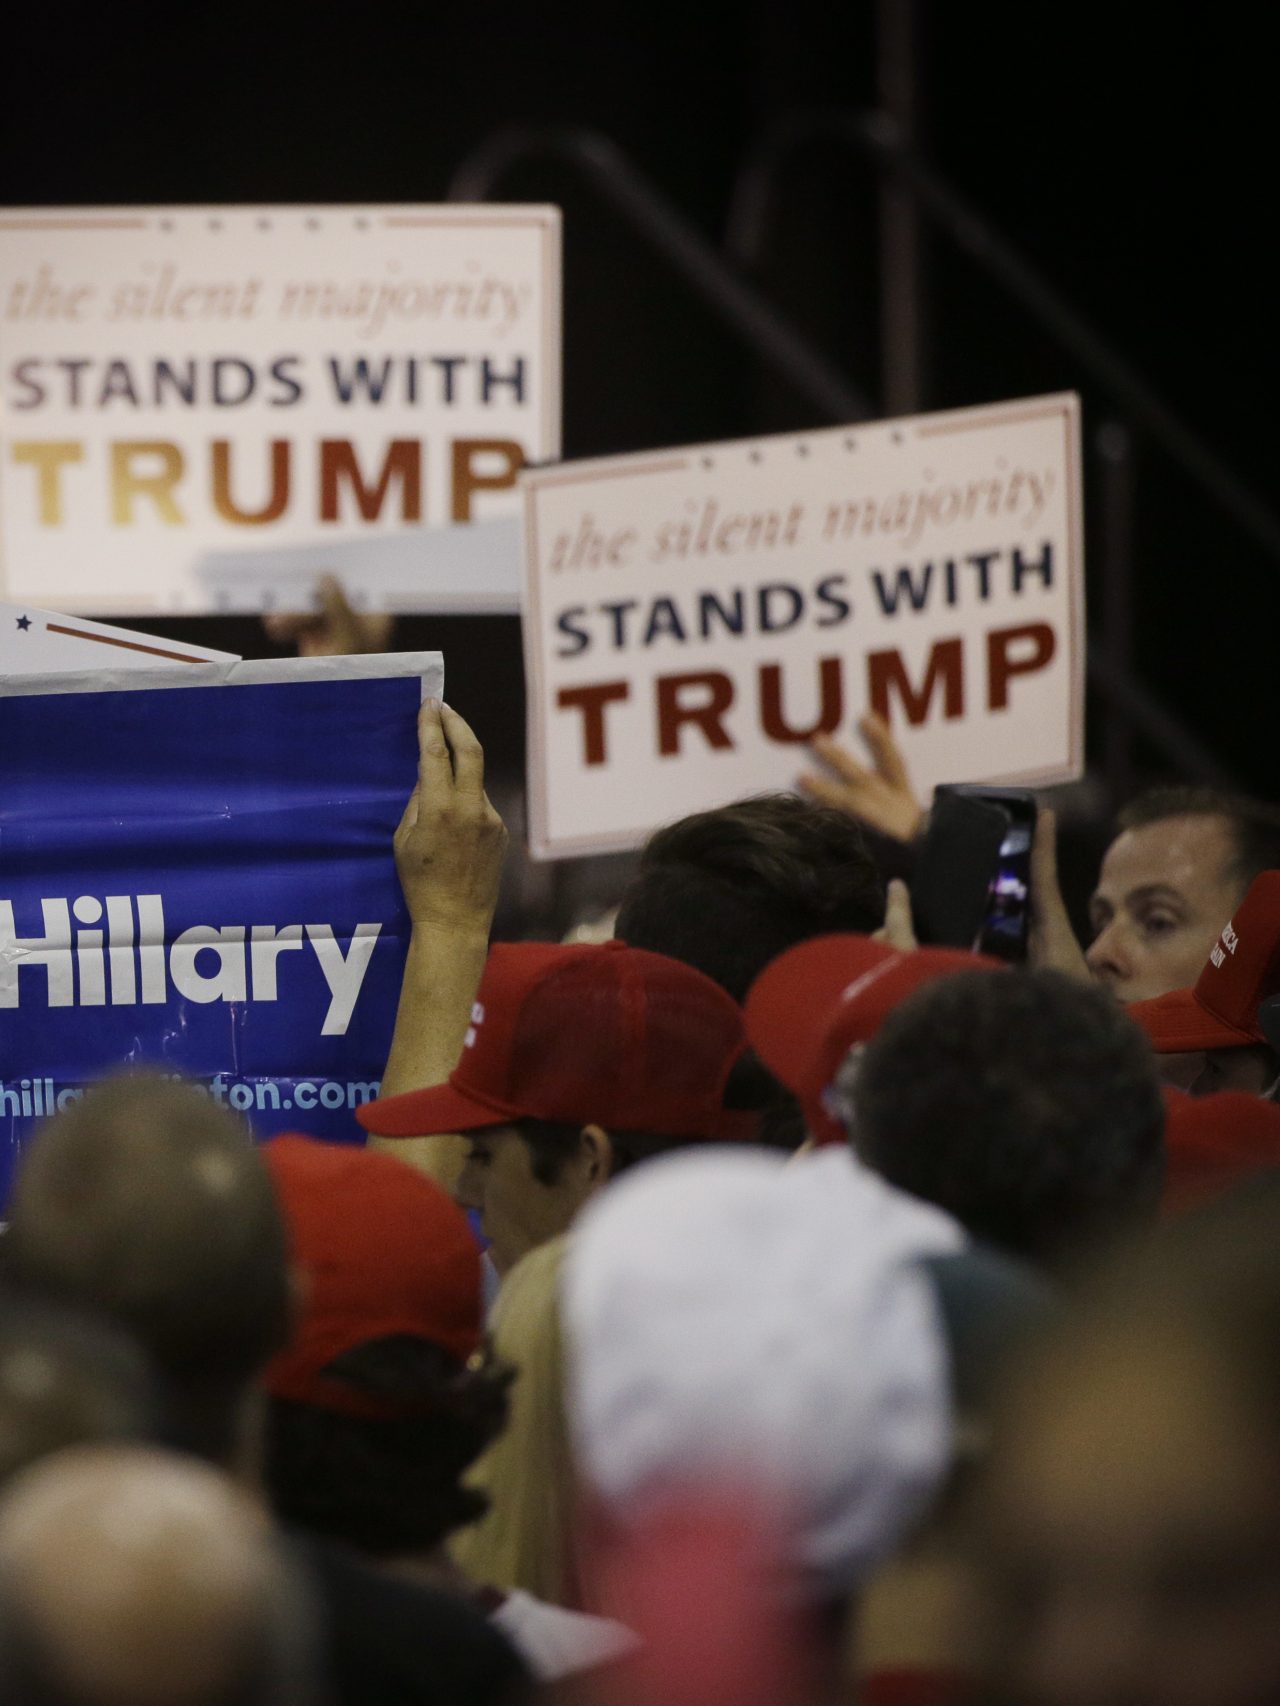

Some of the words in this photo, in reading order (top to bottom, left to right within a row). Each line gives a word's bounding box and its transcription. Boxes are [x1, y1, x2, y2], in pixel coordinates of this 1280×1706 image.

[6, 260, 89, 324] the
[100, 260, 266, 322] silent
[279, 258, 524, 341] majority
[11, 353, 303, 409] STANDS
[328, 353, 528, 409] WITH
[11, 437, 528, 527] TRUMP
[548, 507, 633, 574] the
[653, 494, 804, 562] silent
[821, 455, 1055, 549] majority
[556, 573, 852, 658] STANDS
[870, 541, 1055, 617] WITH
[555, 621, 1058, 768] TRUMP
